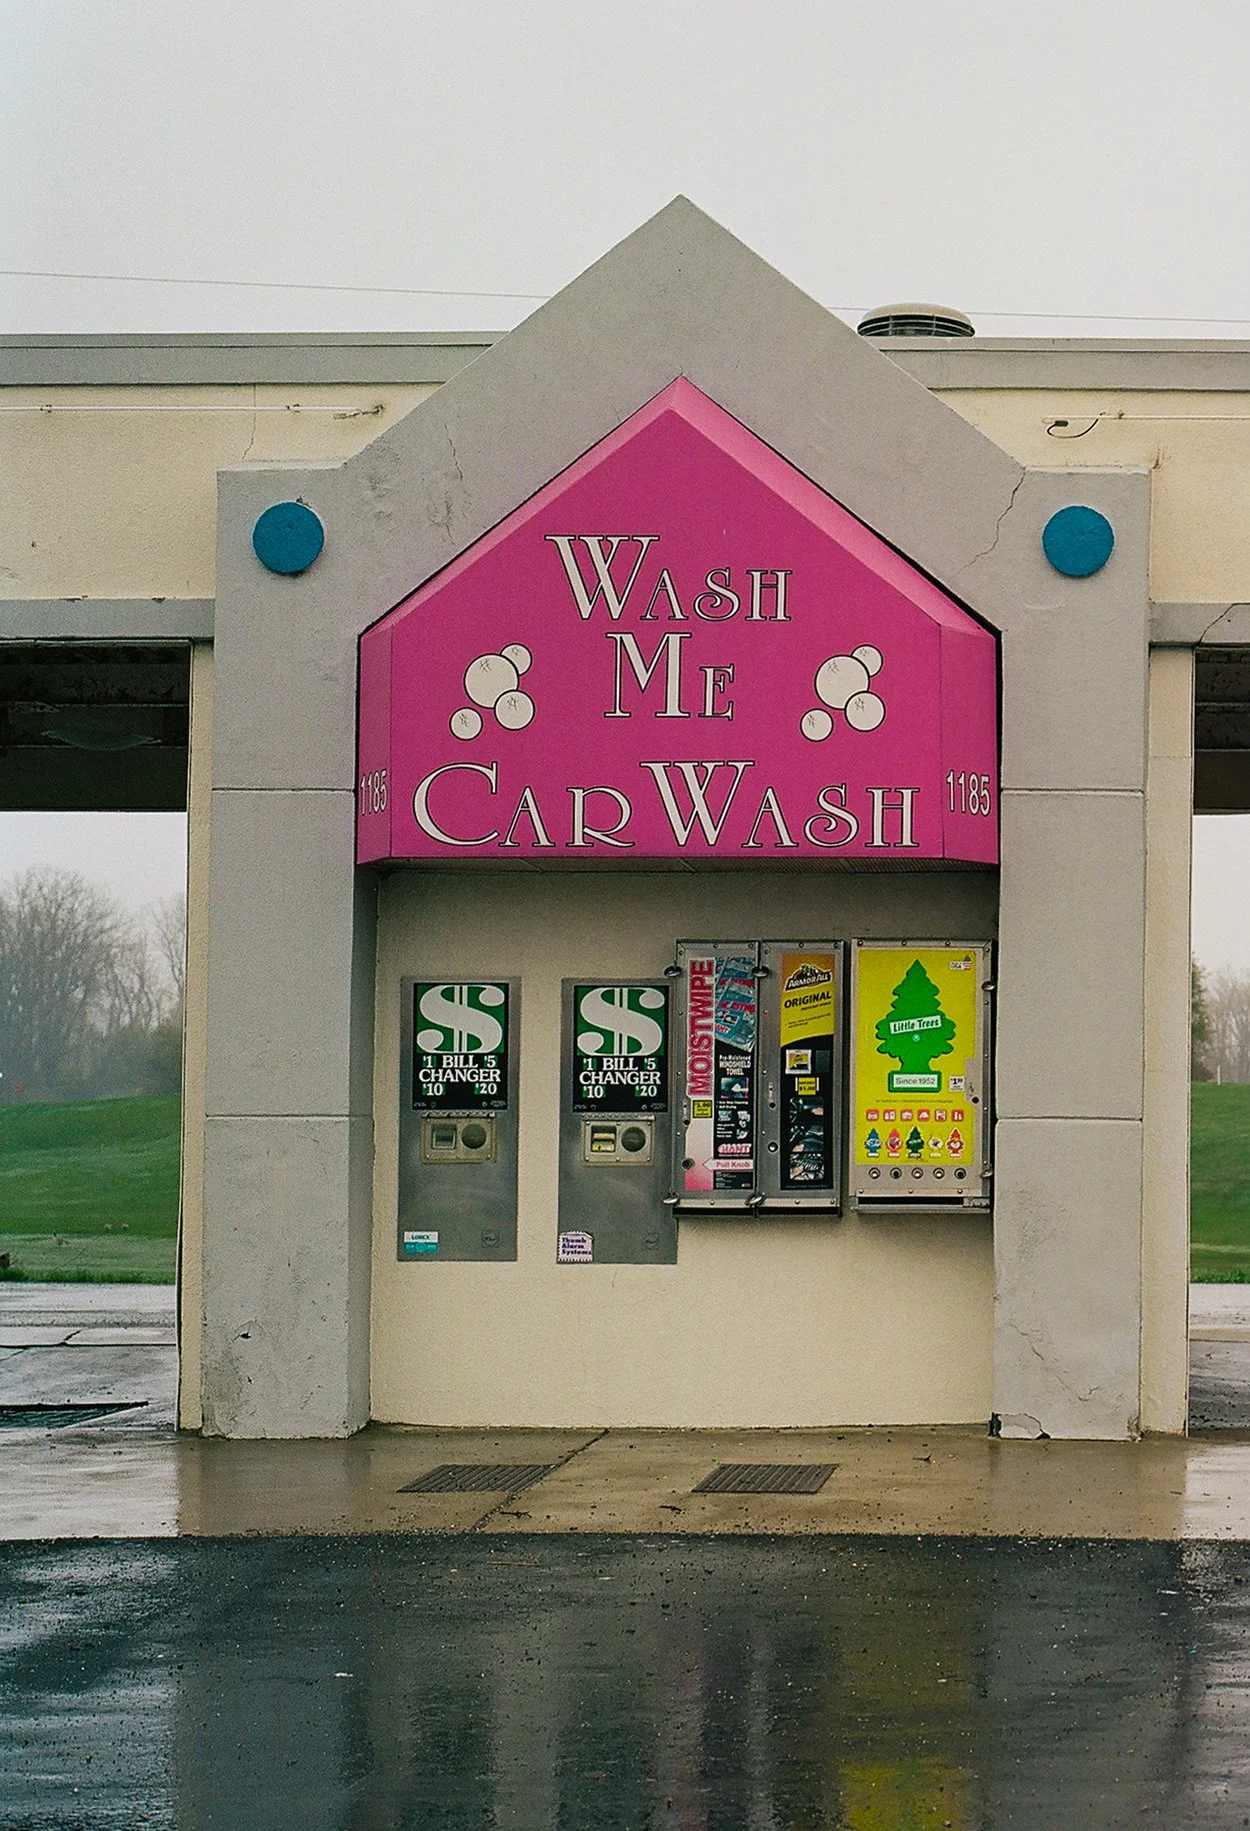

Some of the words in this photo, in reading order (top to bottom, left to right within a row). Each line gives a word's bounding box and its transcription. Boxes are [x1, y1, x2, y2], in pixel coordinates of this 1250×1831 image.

[545, 534, 792, 622] WASH
[361, 768, 387, 816] 1185
[945, 769, 991, 817] 1185
[784, 991, 832, 1008] ORIGINAL
[688, 959, 714, 1096] MOISTWIPE
[893, 1021, 916, 1033] Little
[916, 1018, 940, 1029] Trees
[442, 1055, 479, 1068] BILL
[602, 1057, 639, 1071] BILL
[418, 1068, 502, 1082] CHANGER
[579, 1071, 662, 1085] CHANGER
[895, 1076, 918, 1085] Since
[918, 1077, 936, 1085] 1952
[718, 1143, 752, 1154] GIANT
